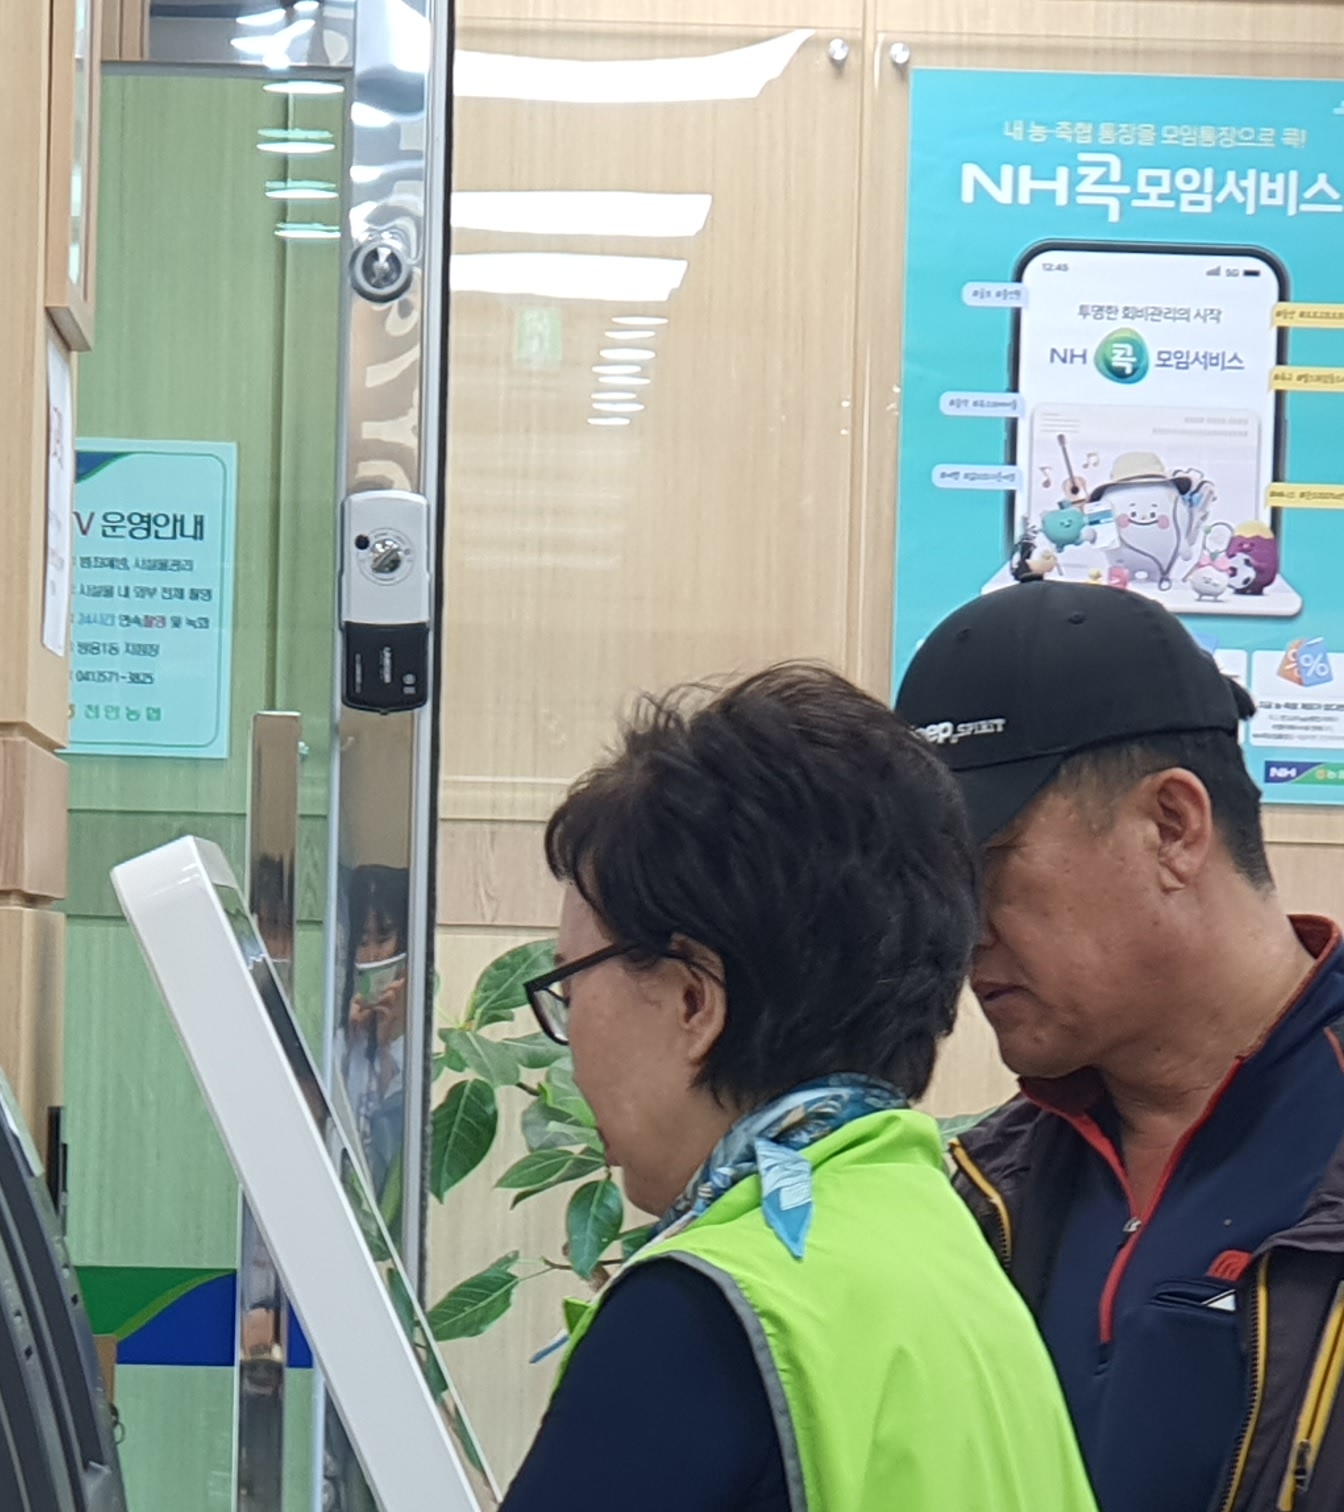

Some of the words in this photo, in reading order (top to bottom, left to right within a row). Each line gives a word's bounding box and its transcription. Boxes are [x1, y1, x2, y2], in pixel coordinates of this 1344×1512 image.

[1004, 120, 1024, 141] 내
[1098, 122, 1155, 146] 통장을
[1161, 124, 1275, 148] 모임통장으로
[1078, 304, 1119, 320] 투명한
[1122, 305, 1191, 323] 회비관리의
[1194, 307, 1222, 323] 시작
[1050, 348, 1087, 364] NH
[1155, 349, 1245, 371] 모임서비스
[101, 510, 205, 541] 운영안내
